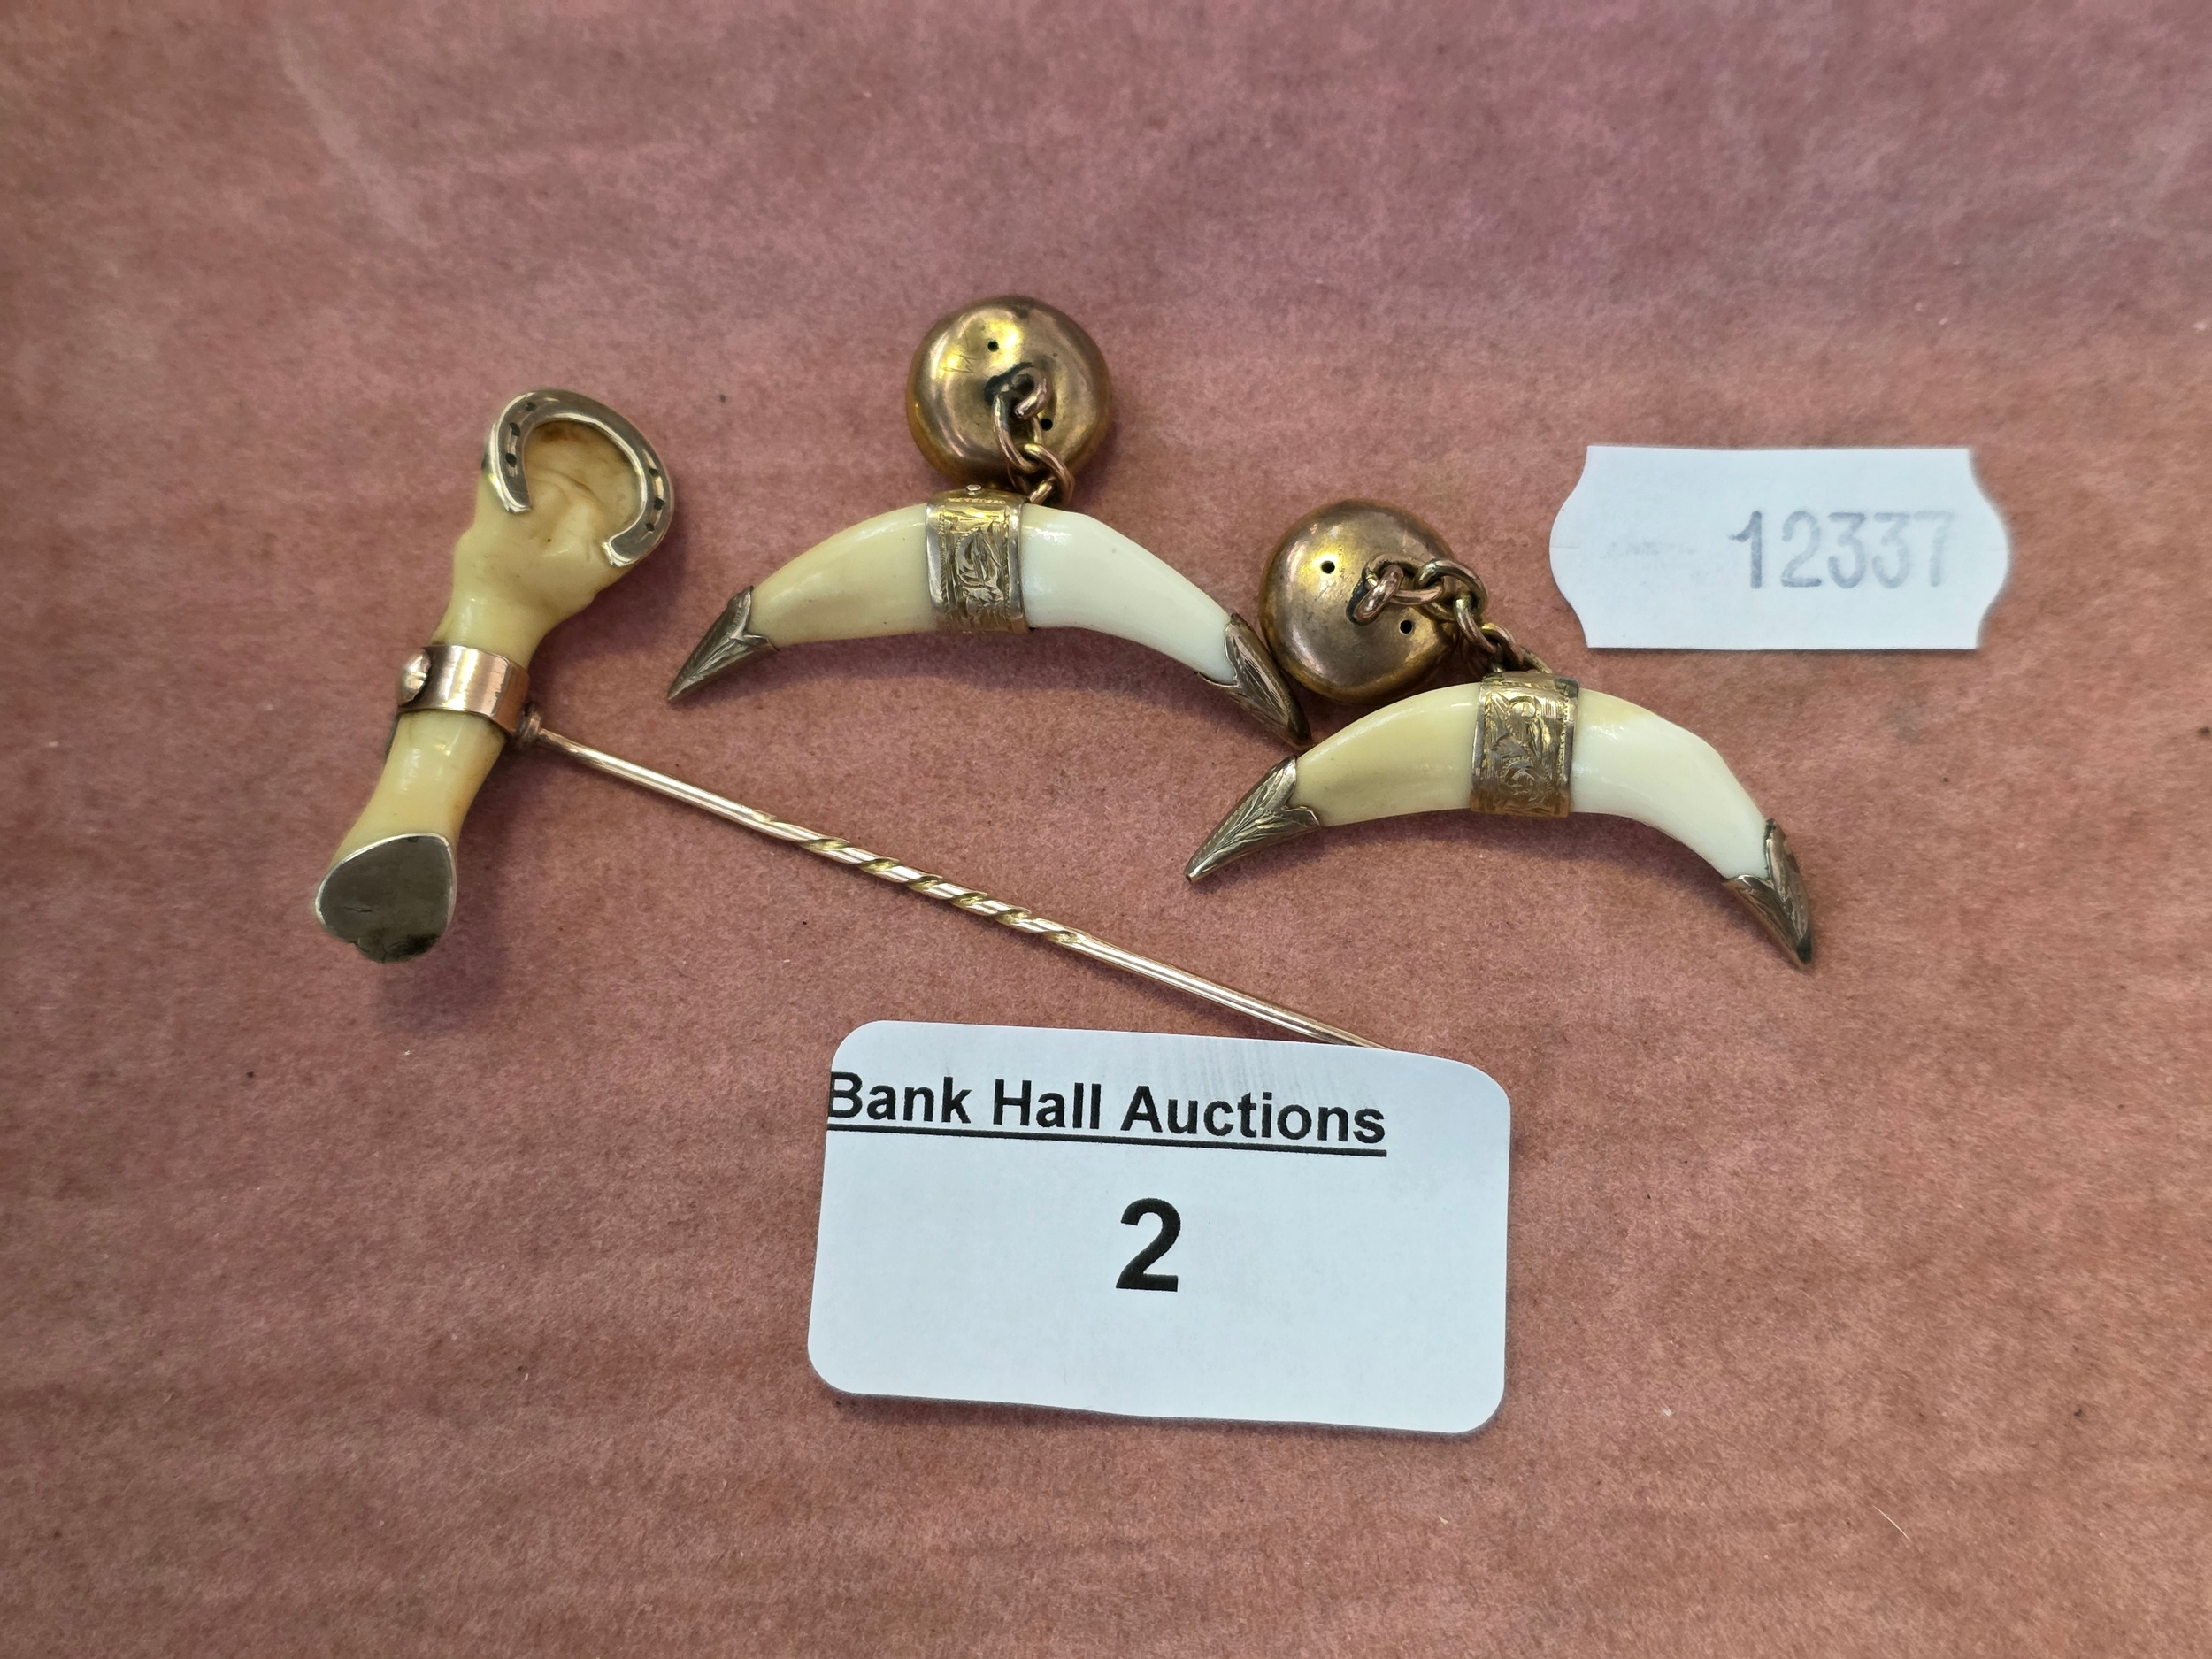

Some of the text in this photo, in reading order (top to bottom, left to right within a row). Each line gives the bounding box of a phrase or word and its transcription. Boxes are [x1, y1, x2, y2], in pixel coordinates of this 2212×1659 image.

[1730, 510, 1955, 590] 12337
[828, 1071, 1386, 1144] Bank Hall Auctions
[1115, 1197, 1182, 1293] 2
